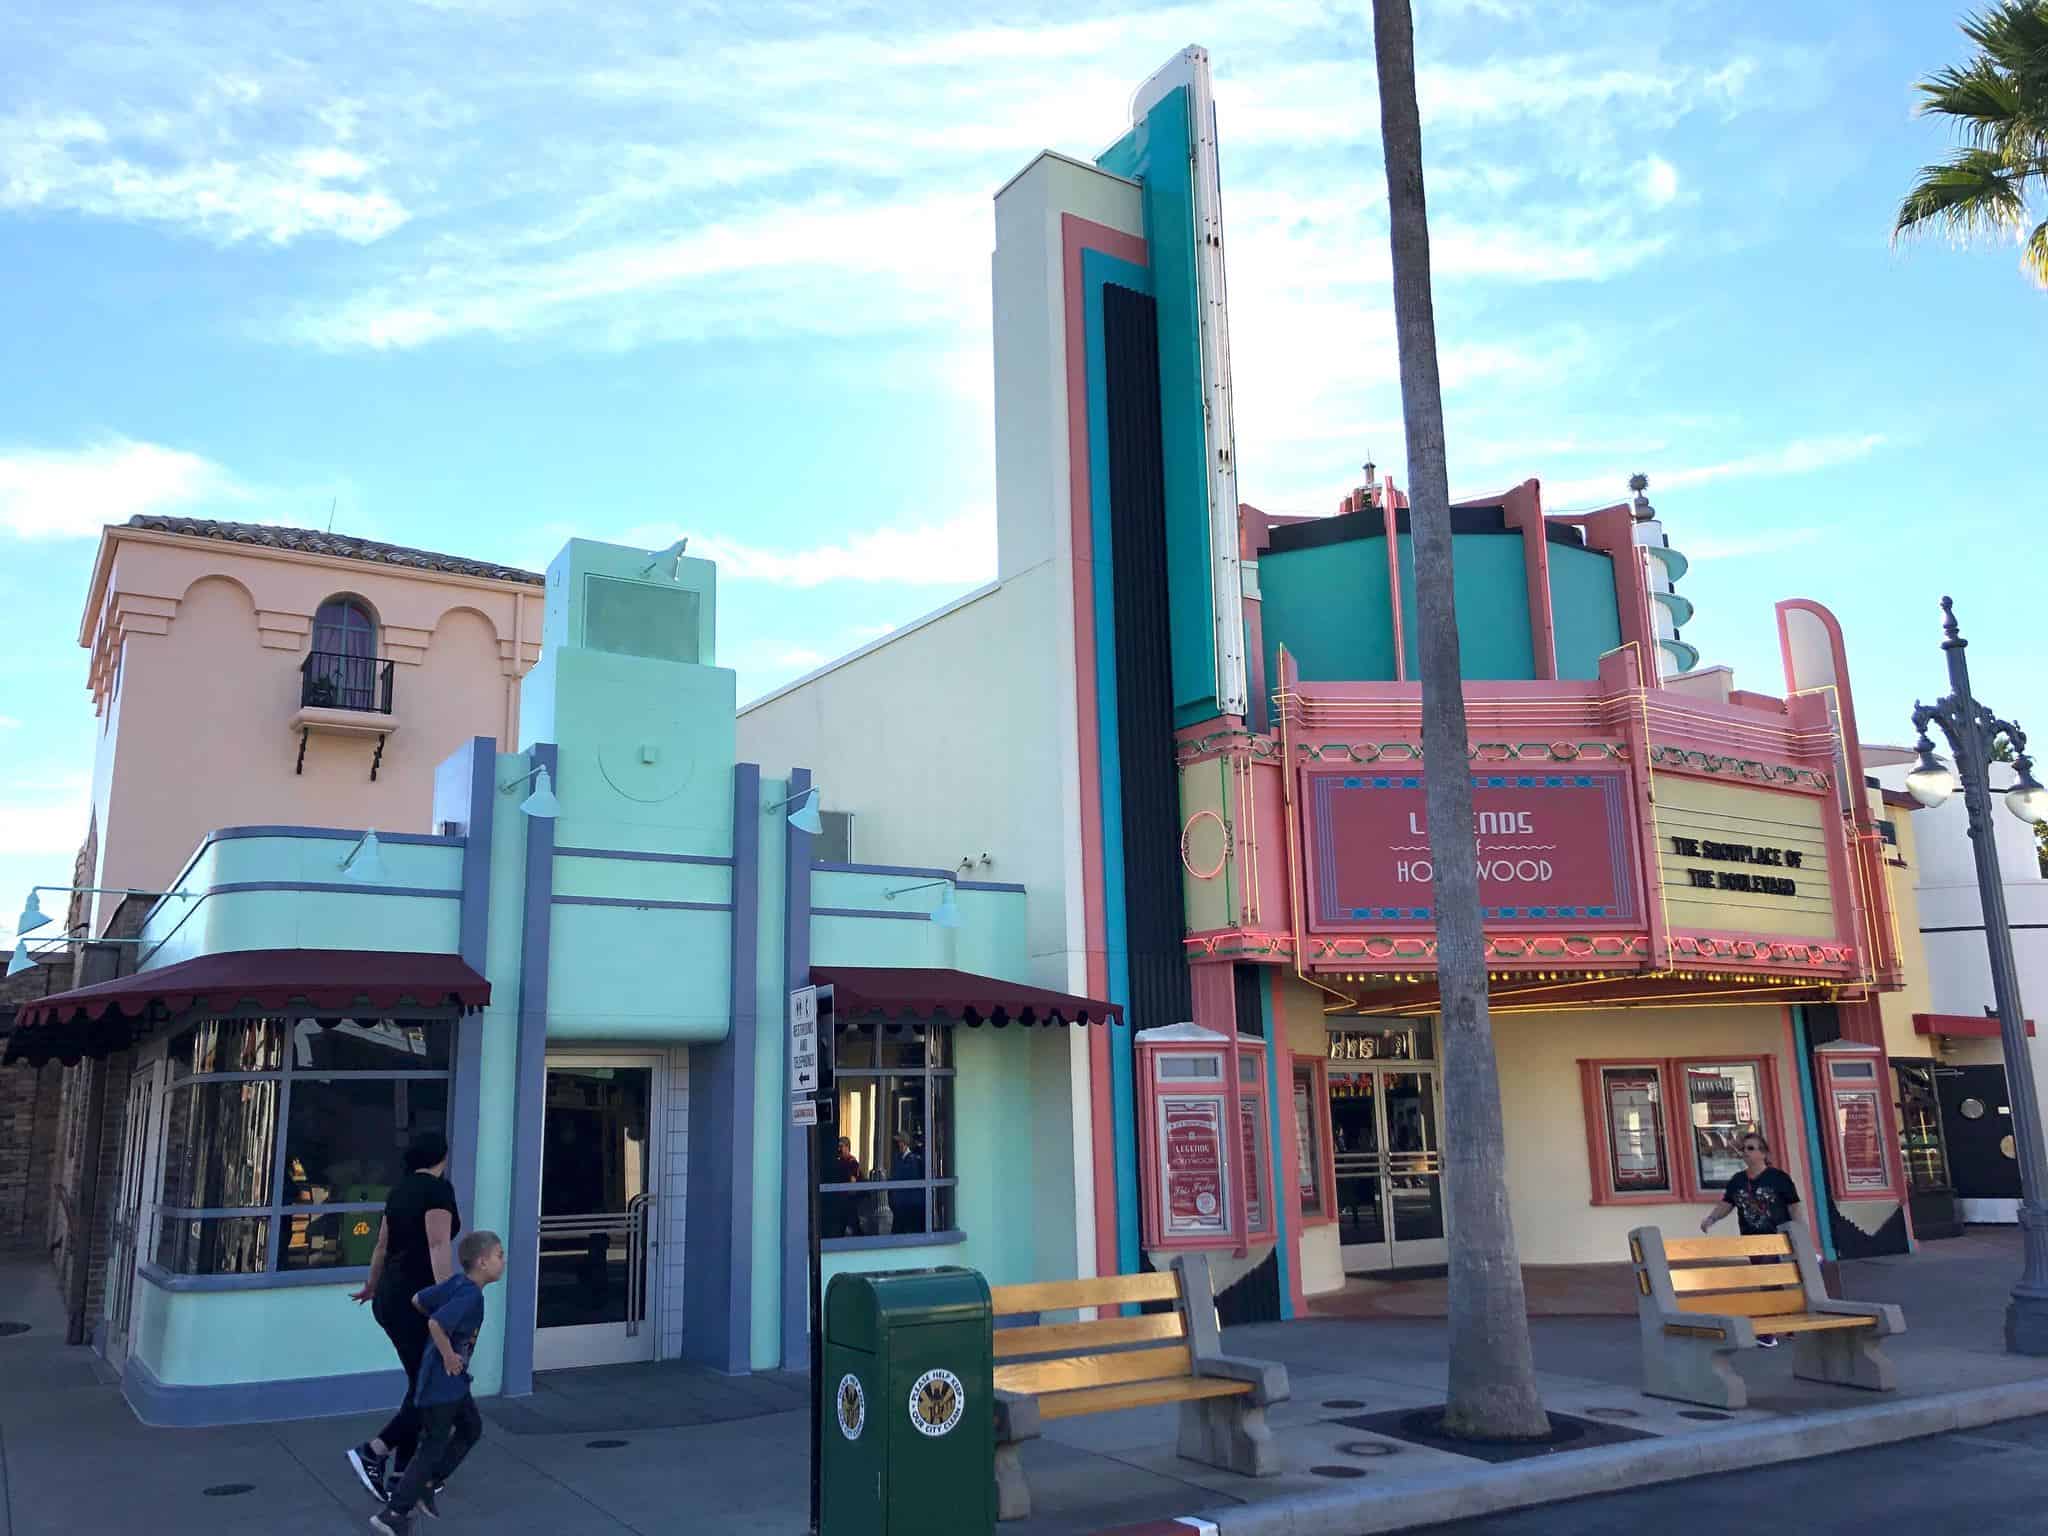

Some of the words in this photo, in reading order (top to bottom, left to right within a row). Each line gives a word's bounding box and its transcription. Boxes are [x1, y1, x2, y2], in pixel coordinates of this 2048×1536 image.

[1409, 811, 1534, 835] LNDS
[1671, 835, 1700, 857] THE
[1702, 840, 1783, 867] SHOWPLACE
[1784, 849, 1802, 869] OF
[1396, 859, 1553, 883] HOWOOD
[1687, 868, 1716, 889] THE
[1717, 871, 1796, 896] BOULEVARD
[911, 1375, 930, 1401] PLEASE
[932, 1371, 951, 1379] HELP
[951, 1377, 962, 1397] KEEP
[912, 1410, 925, 1428] OUR
[925, 1425, 941, 1433] CITY
[943, 1407, 961, 1430] CLEAN
